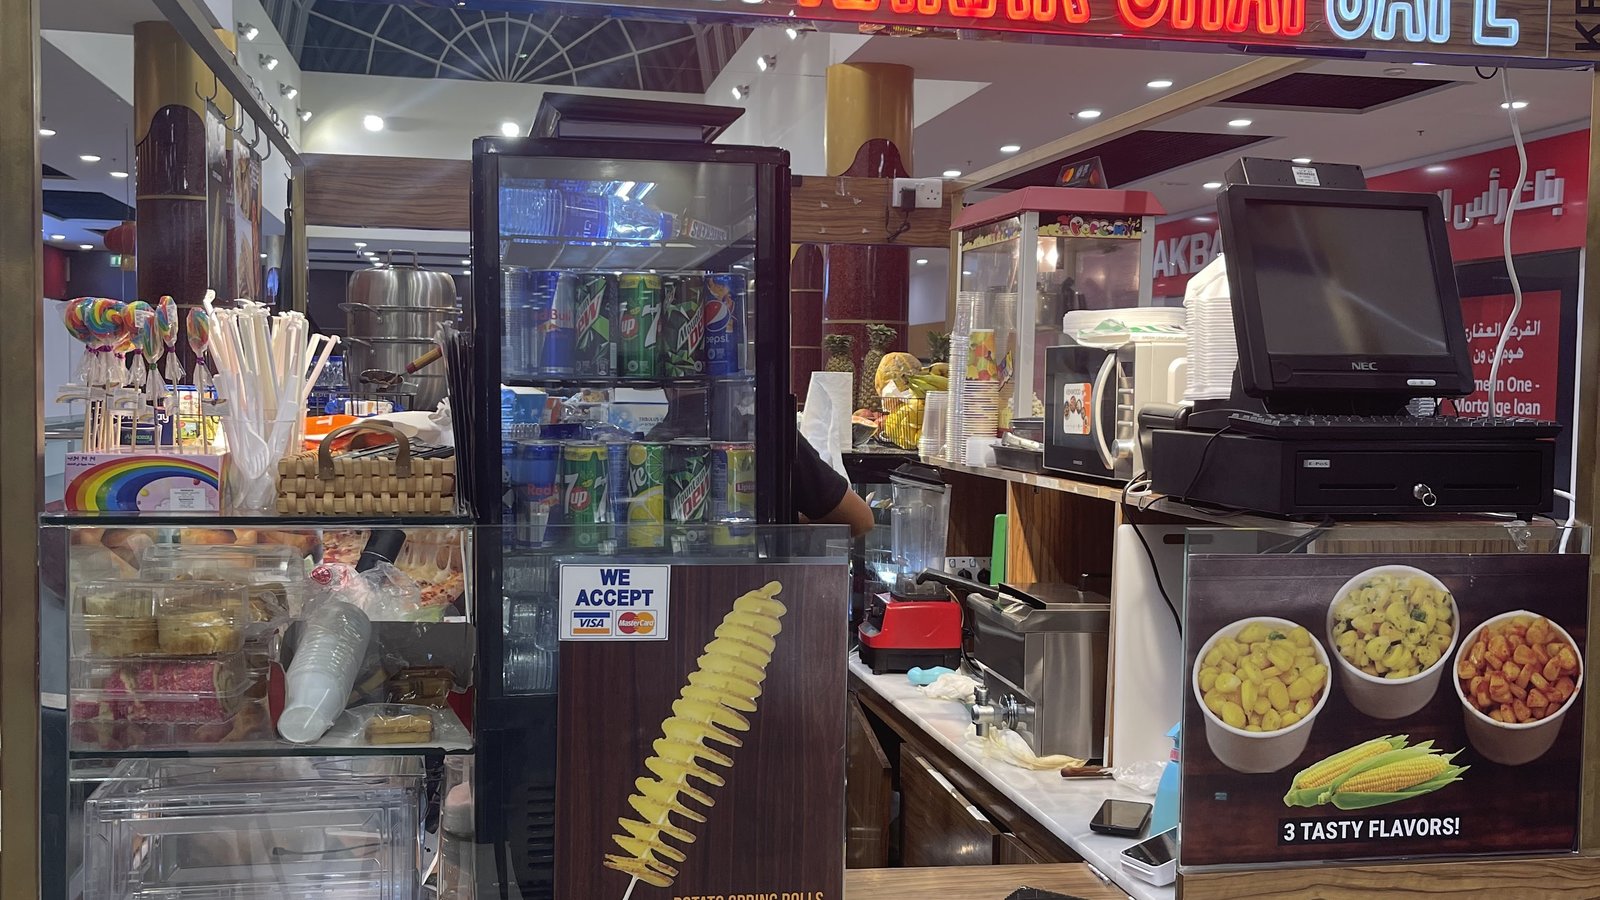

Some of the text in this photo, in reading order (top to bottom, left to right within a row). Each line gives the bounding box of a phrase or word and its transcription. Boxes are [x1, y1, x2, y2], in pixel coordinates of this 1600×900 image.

[1351, 361, 1378, 371] NEC
[1507, 376, 1532, 392] One
[1455, 398, 1541, 417] Mortgge loan
[600, 569, 630, 586] WE
[575, 589, 654, 606] ACCEPT
[580, 618, 654, 628] VISA MasterCard
[1283, 817, 1460, 841] 3 TASTY FLAVORS!
